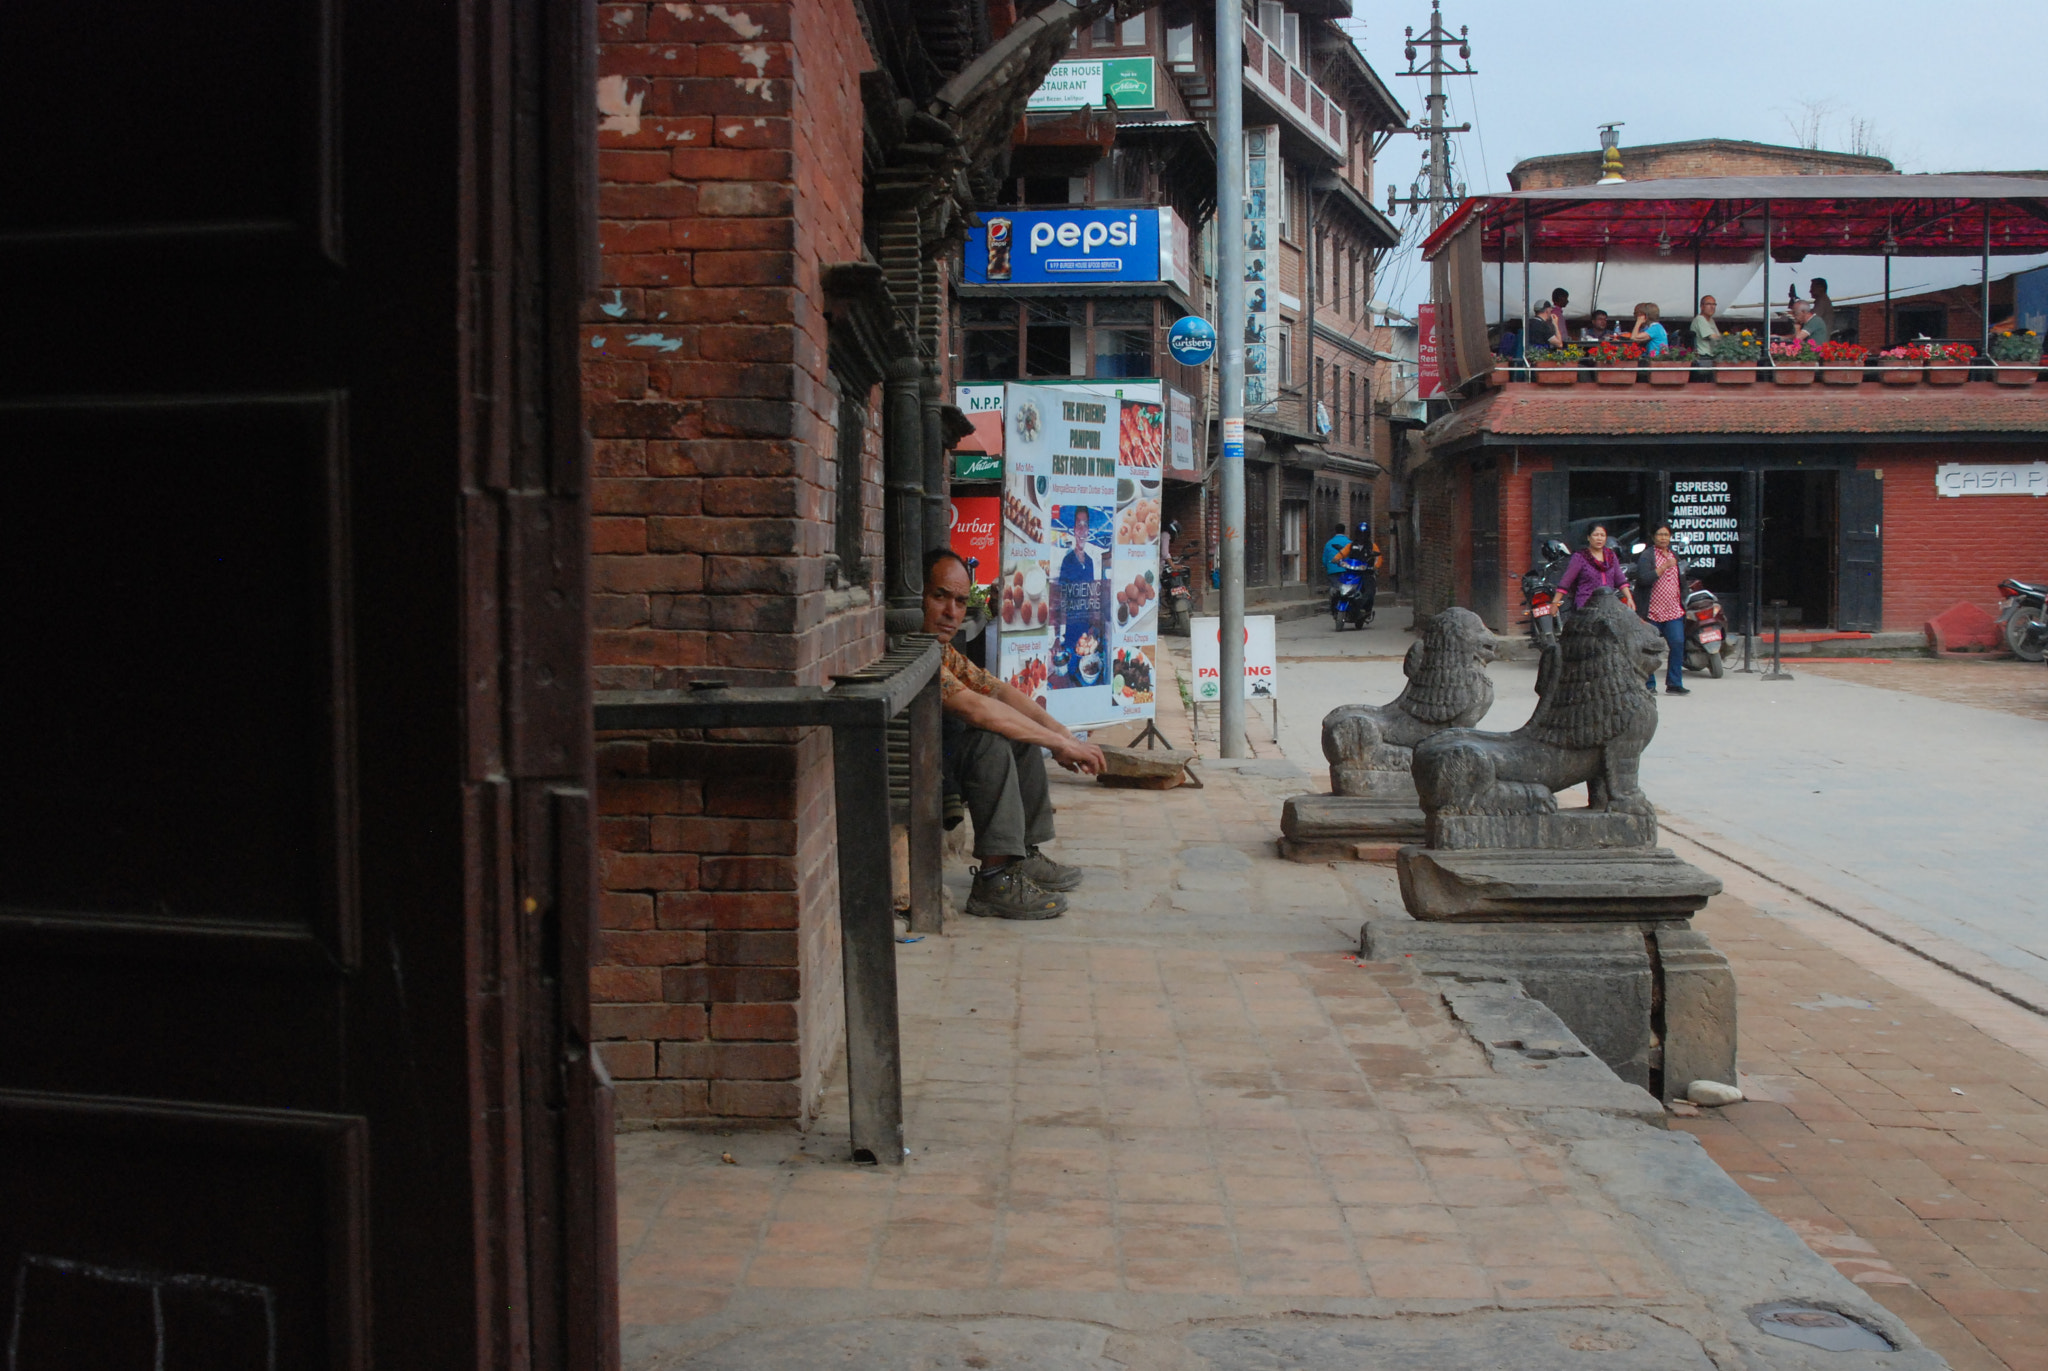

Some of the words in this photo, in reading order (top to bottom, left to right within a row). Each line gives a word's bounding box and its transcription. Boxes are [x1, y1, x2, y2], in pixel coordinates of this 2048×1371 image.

[1071, 66, 1101, 76] HOUSE
[1030, 214, 1138, 254] pepsi
[1172, 335, 1212, 350] Carlsberg
[1428, 335, 1437, 344] C
[1420, 355, 1438, 363] Rest
[970, 397, 1003, 410] N.P.P.
[1062, 401, 1076, 422] THE
[1075, 402, 1107, 424] HYGIENIC
[1069, 429, 1101, 450] PANIPURI
[1015, 463, 1024, 472] Mo
[1025, 463, 1034, 472] Mo
[1052, 454, 1069, 475] FAST
[1069, 455, 1087, 476] FOOD
[1087, 457, 1096, 477] IN
[1096, 457, 1116, 478] TOWN
[1129, 467, 1150, 478] Sausage
[1945, 471, 2017, 489] CASA
[2028, 471, 2048, 488] P
[1675, 481, 1728, 492] ESPRESSO
[1671, 494, 1698, 503] CAFE
[1699, 493, 1731, 503] LATTE
[1673, 505, 1727, 516] AMERICANO
[1669, 531, 1705, 542] LENDED
[1706, 531, 1740, 542] MOCHA
[1024, 547, 1037, 557] Stick
[1712, 544, 1733, 554] TEA
[1011, 642, 1031, 652] Cheese
[1198, 666, 1272, 678] PAING
